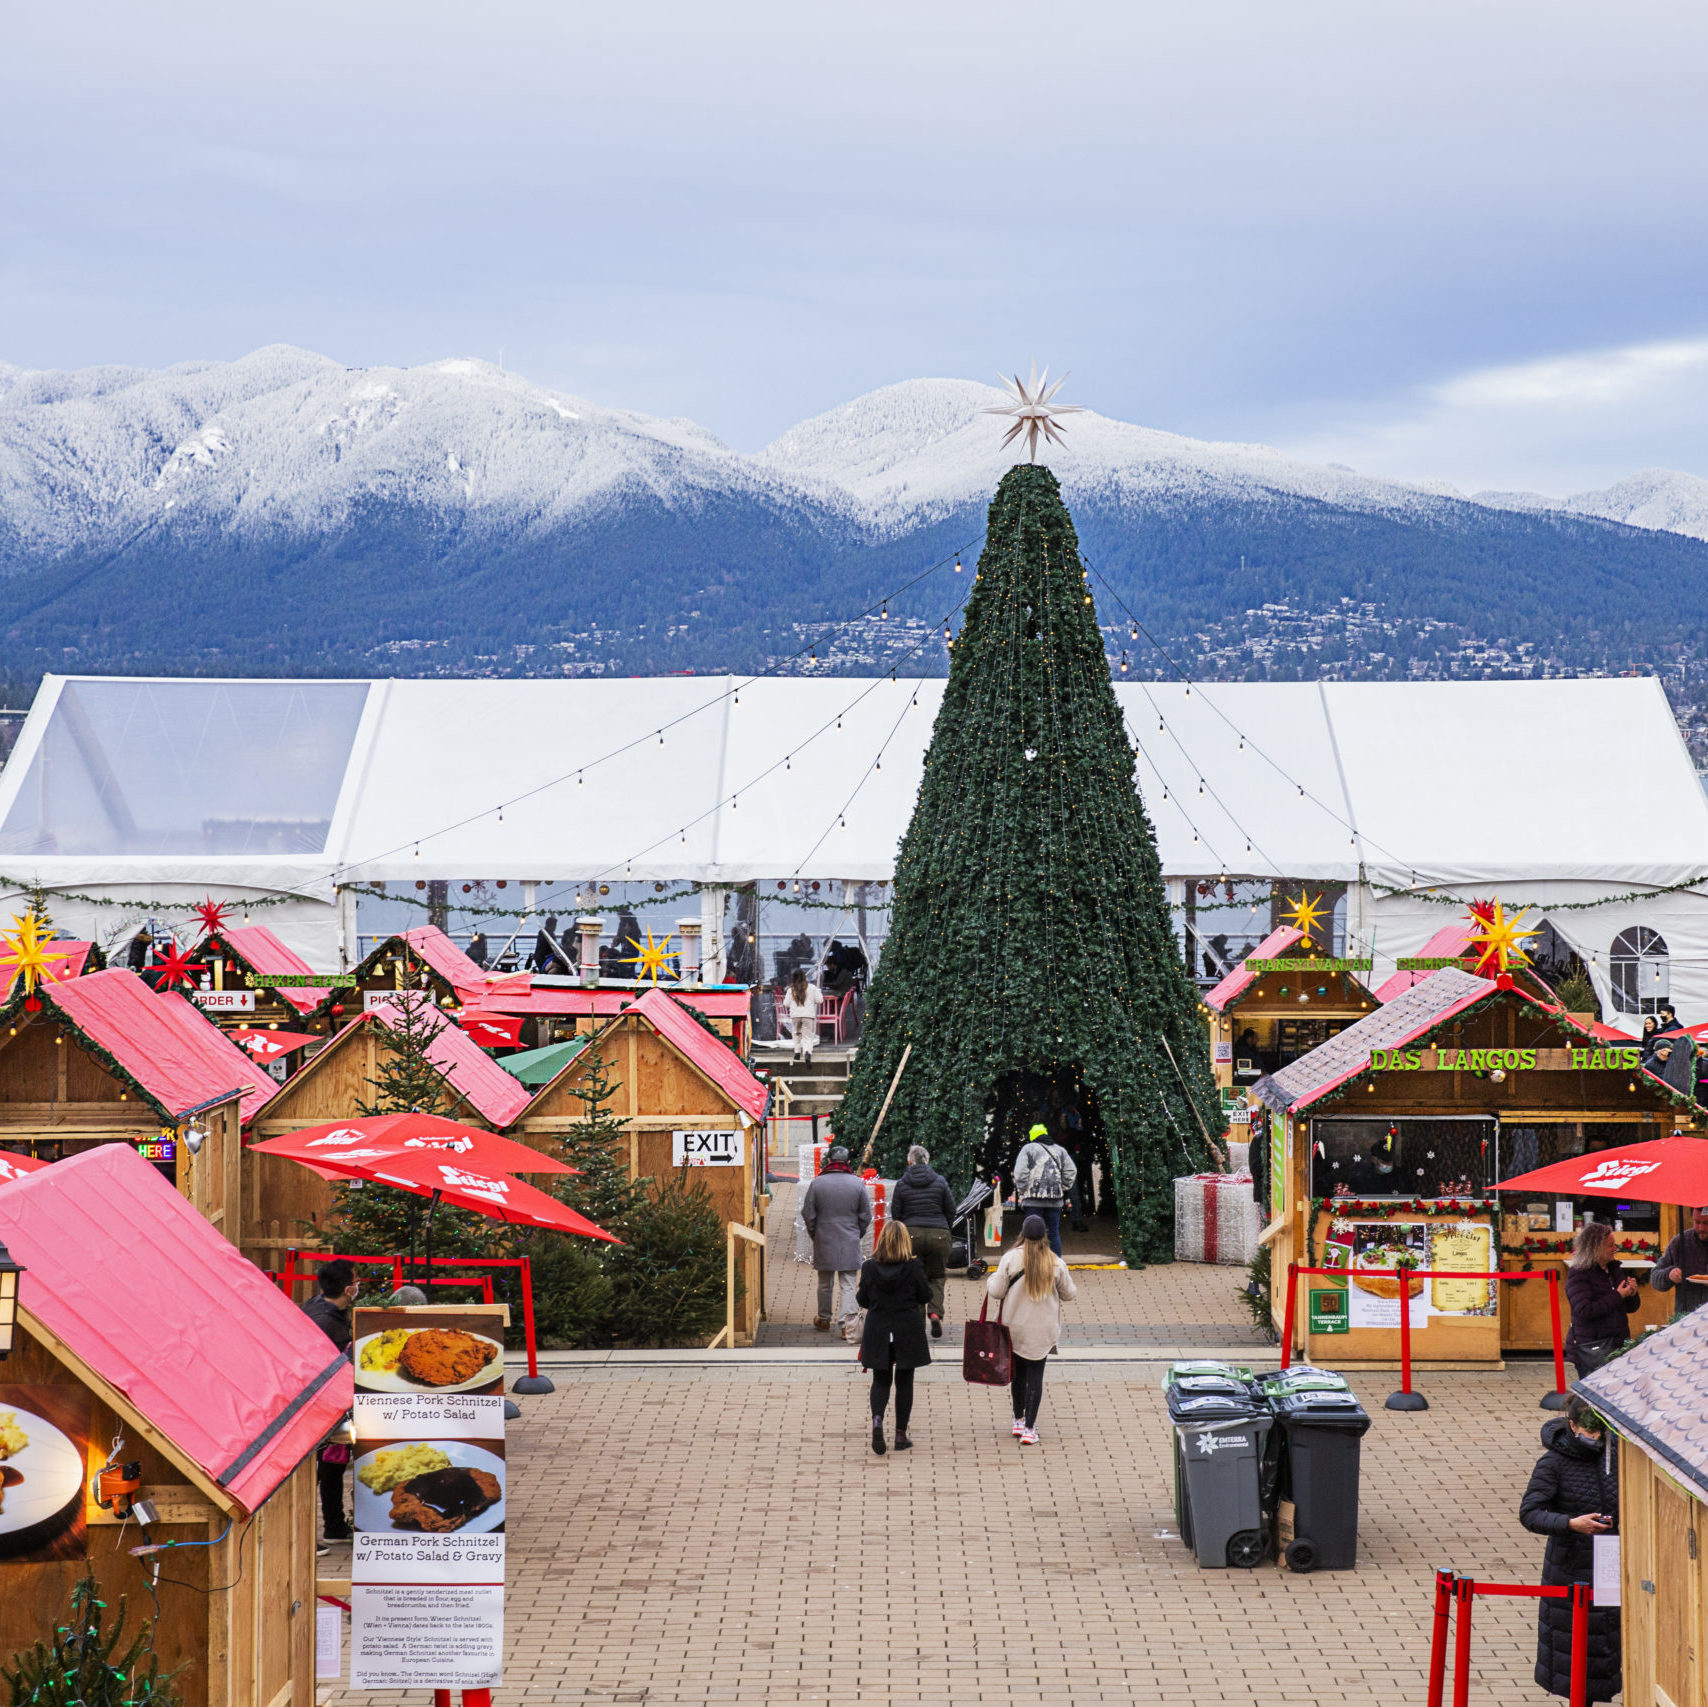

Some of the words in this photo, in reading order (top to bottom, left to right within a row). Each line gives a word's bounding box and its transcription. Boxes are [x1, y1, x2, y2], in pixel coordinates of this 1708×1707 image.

[1246, 959, 1372, 971] TRANSYLVANIAN
[254, 975, 306, 986] HAXEN
[313, 975, 356, 986] HAUS
[1372, 1050, 1421, 1070] DAS
[1437, 1050, 1536, 1070] LANGOS
[1572, 1050, 1638, 1070] HAUS
[684, 1134, 734, 1151] EXIT
[138, 1144, 171, 1158] HERE
[1578, 1160, 1663, 1181] Stiegl
[356, 1396, 412, 1405] Viennese
[416, 1395, 443, 1405] Pork
[446, 1396, 501, 1407] Schnitzel
[383, 1410, 398, 1420] w/
[402, 1410, 441, 1419] Potato
[443, 1410, 475, 1419] Salad
[360, 1536, 408, 1546] German
[412, 1537, 439, 1547] Pork
[442, 1537, 499, 1547] Schnitzel
[356, 1551, 372, 1561] w/
[375, 1551, 414, 1561] Potato
[416, 1551, 449, 1561] Salad
[452, 1551, 462, 1561] &
[466, 1551, 502, 1563] Gravy
